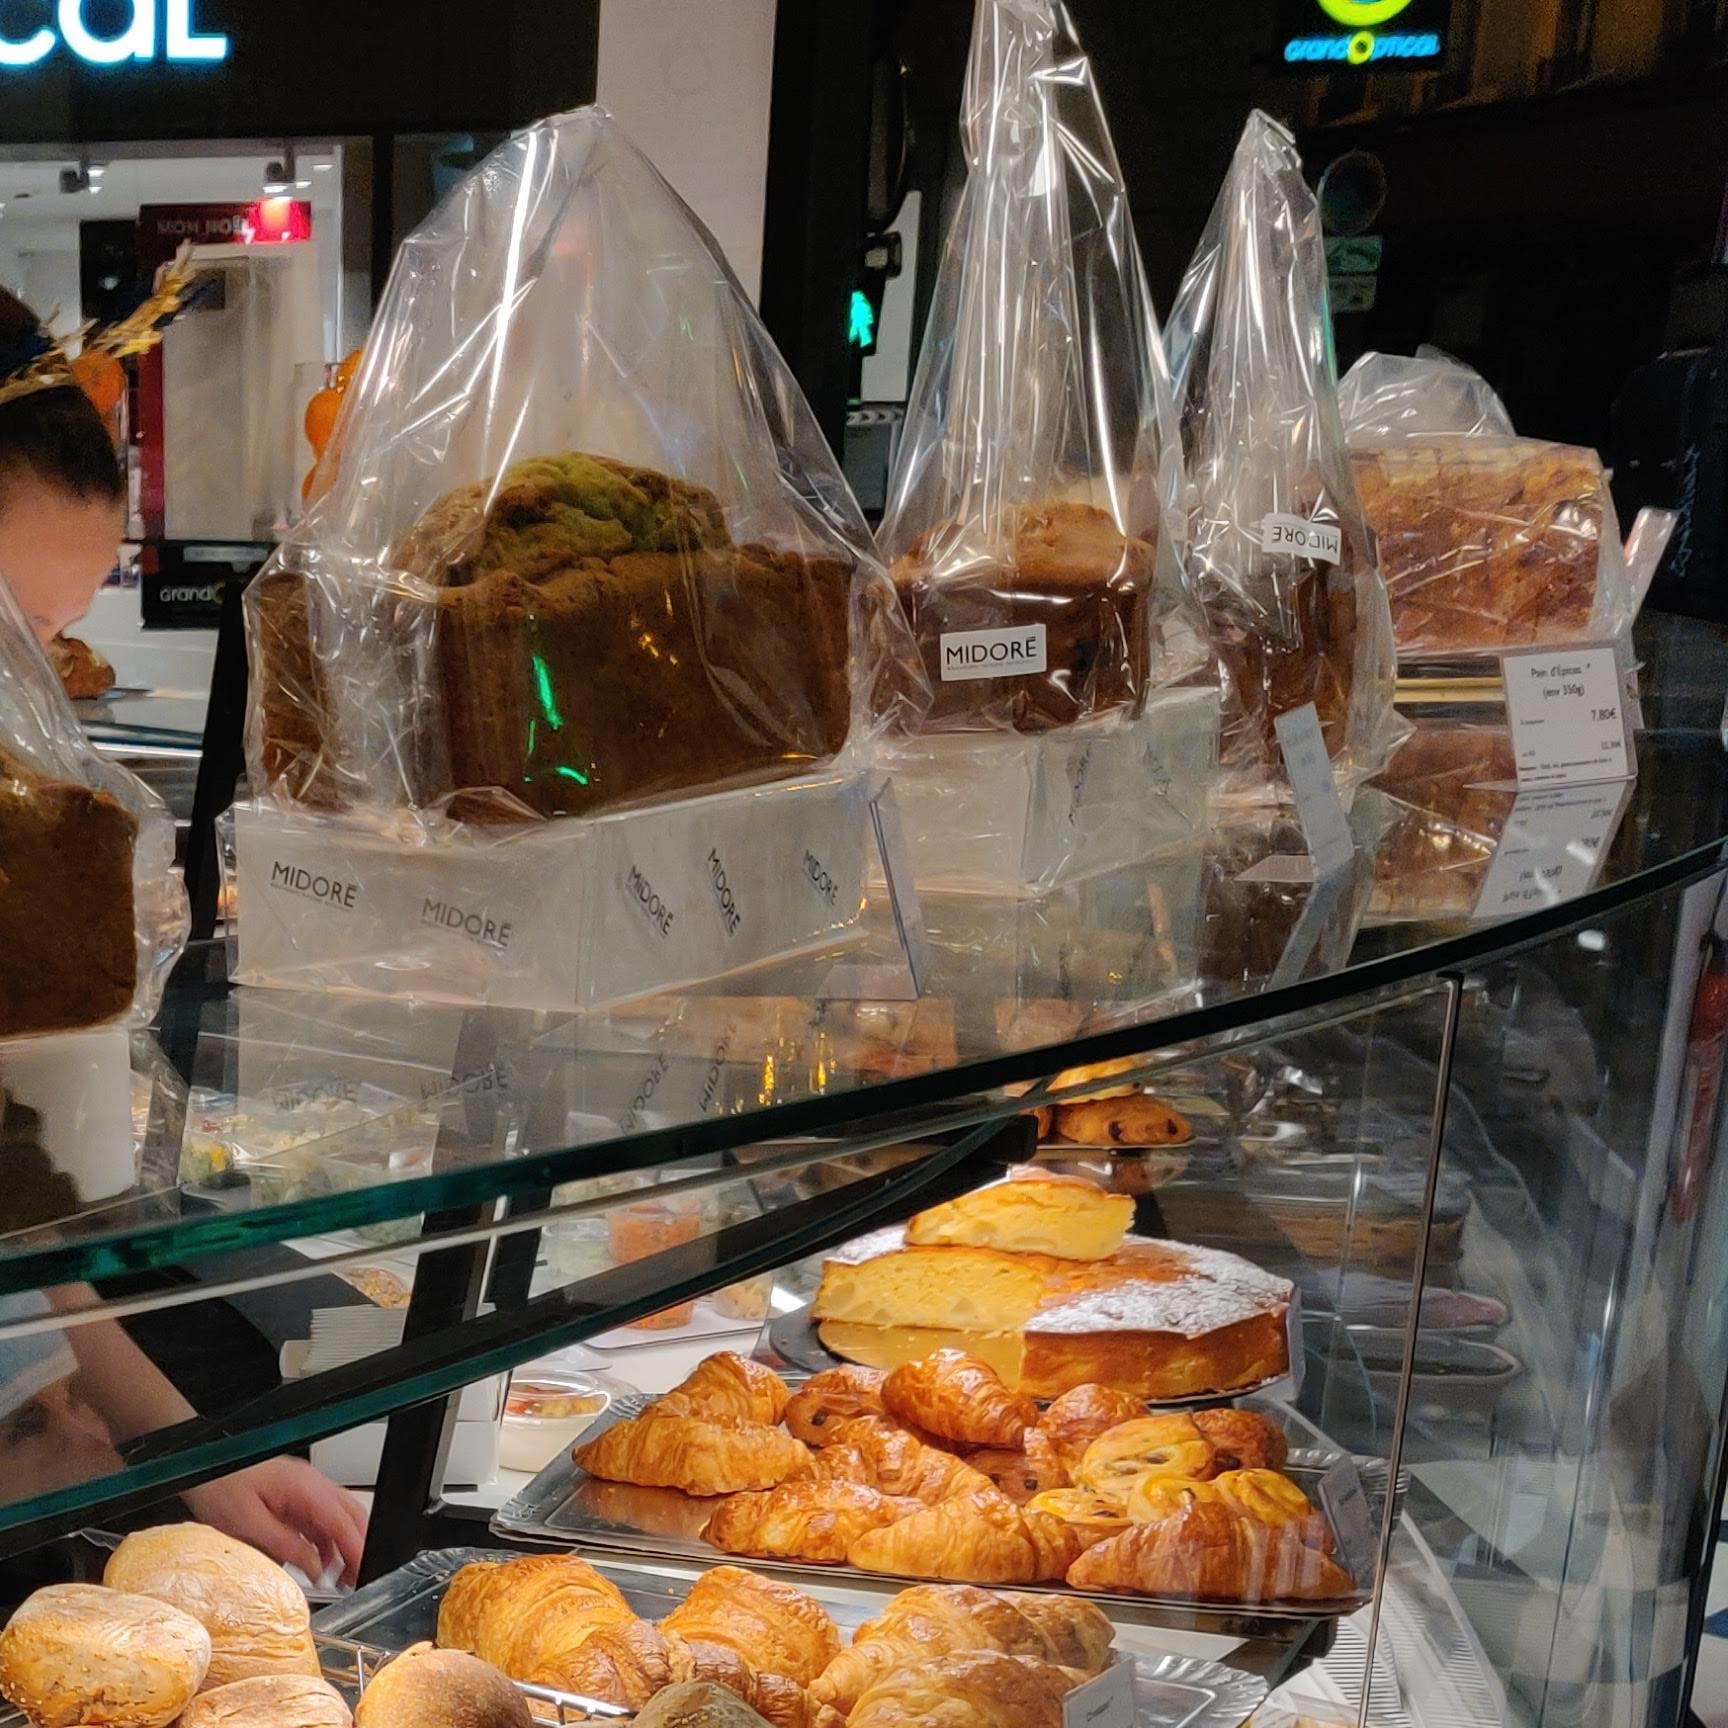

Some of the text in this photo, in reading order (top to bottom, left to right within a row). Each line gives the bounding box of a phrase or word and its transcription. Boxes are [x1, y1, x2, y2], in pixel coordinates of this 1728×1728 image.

[946, 635, 1037, 665] MIDORÉ
[272, 861, 358, 908] MIDORÉ
[422, 898, 513, 948] MIDORÉ
